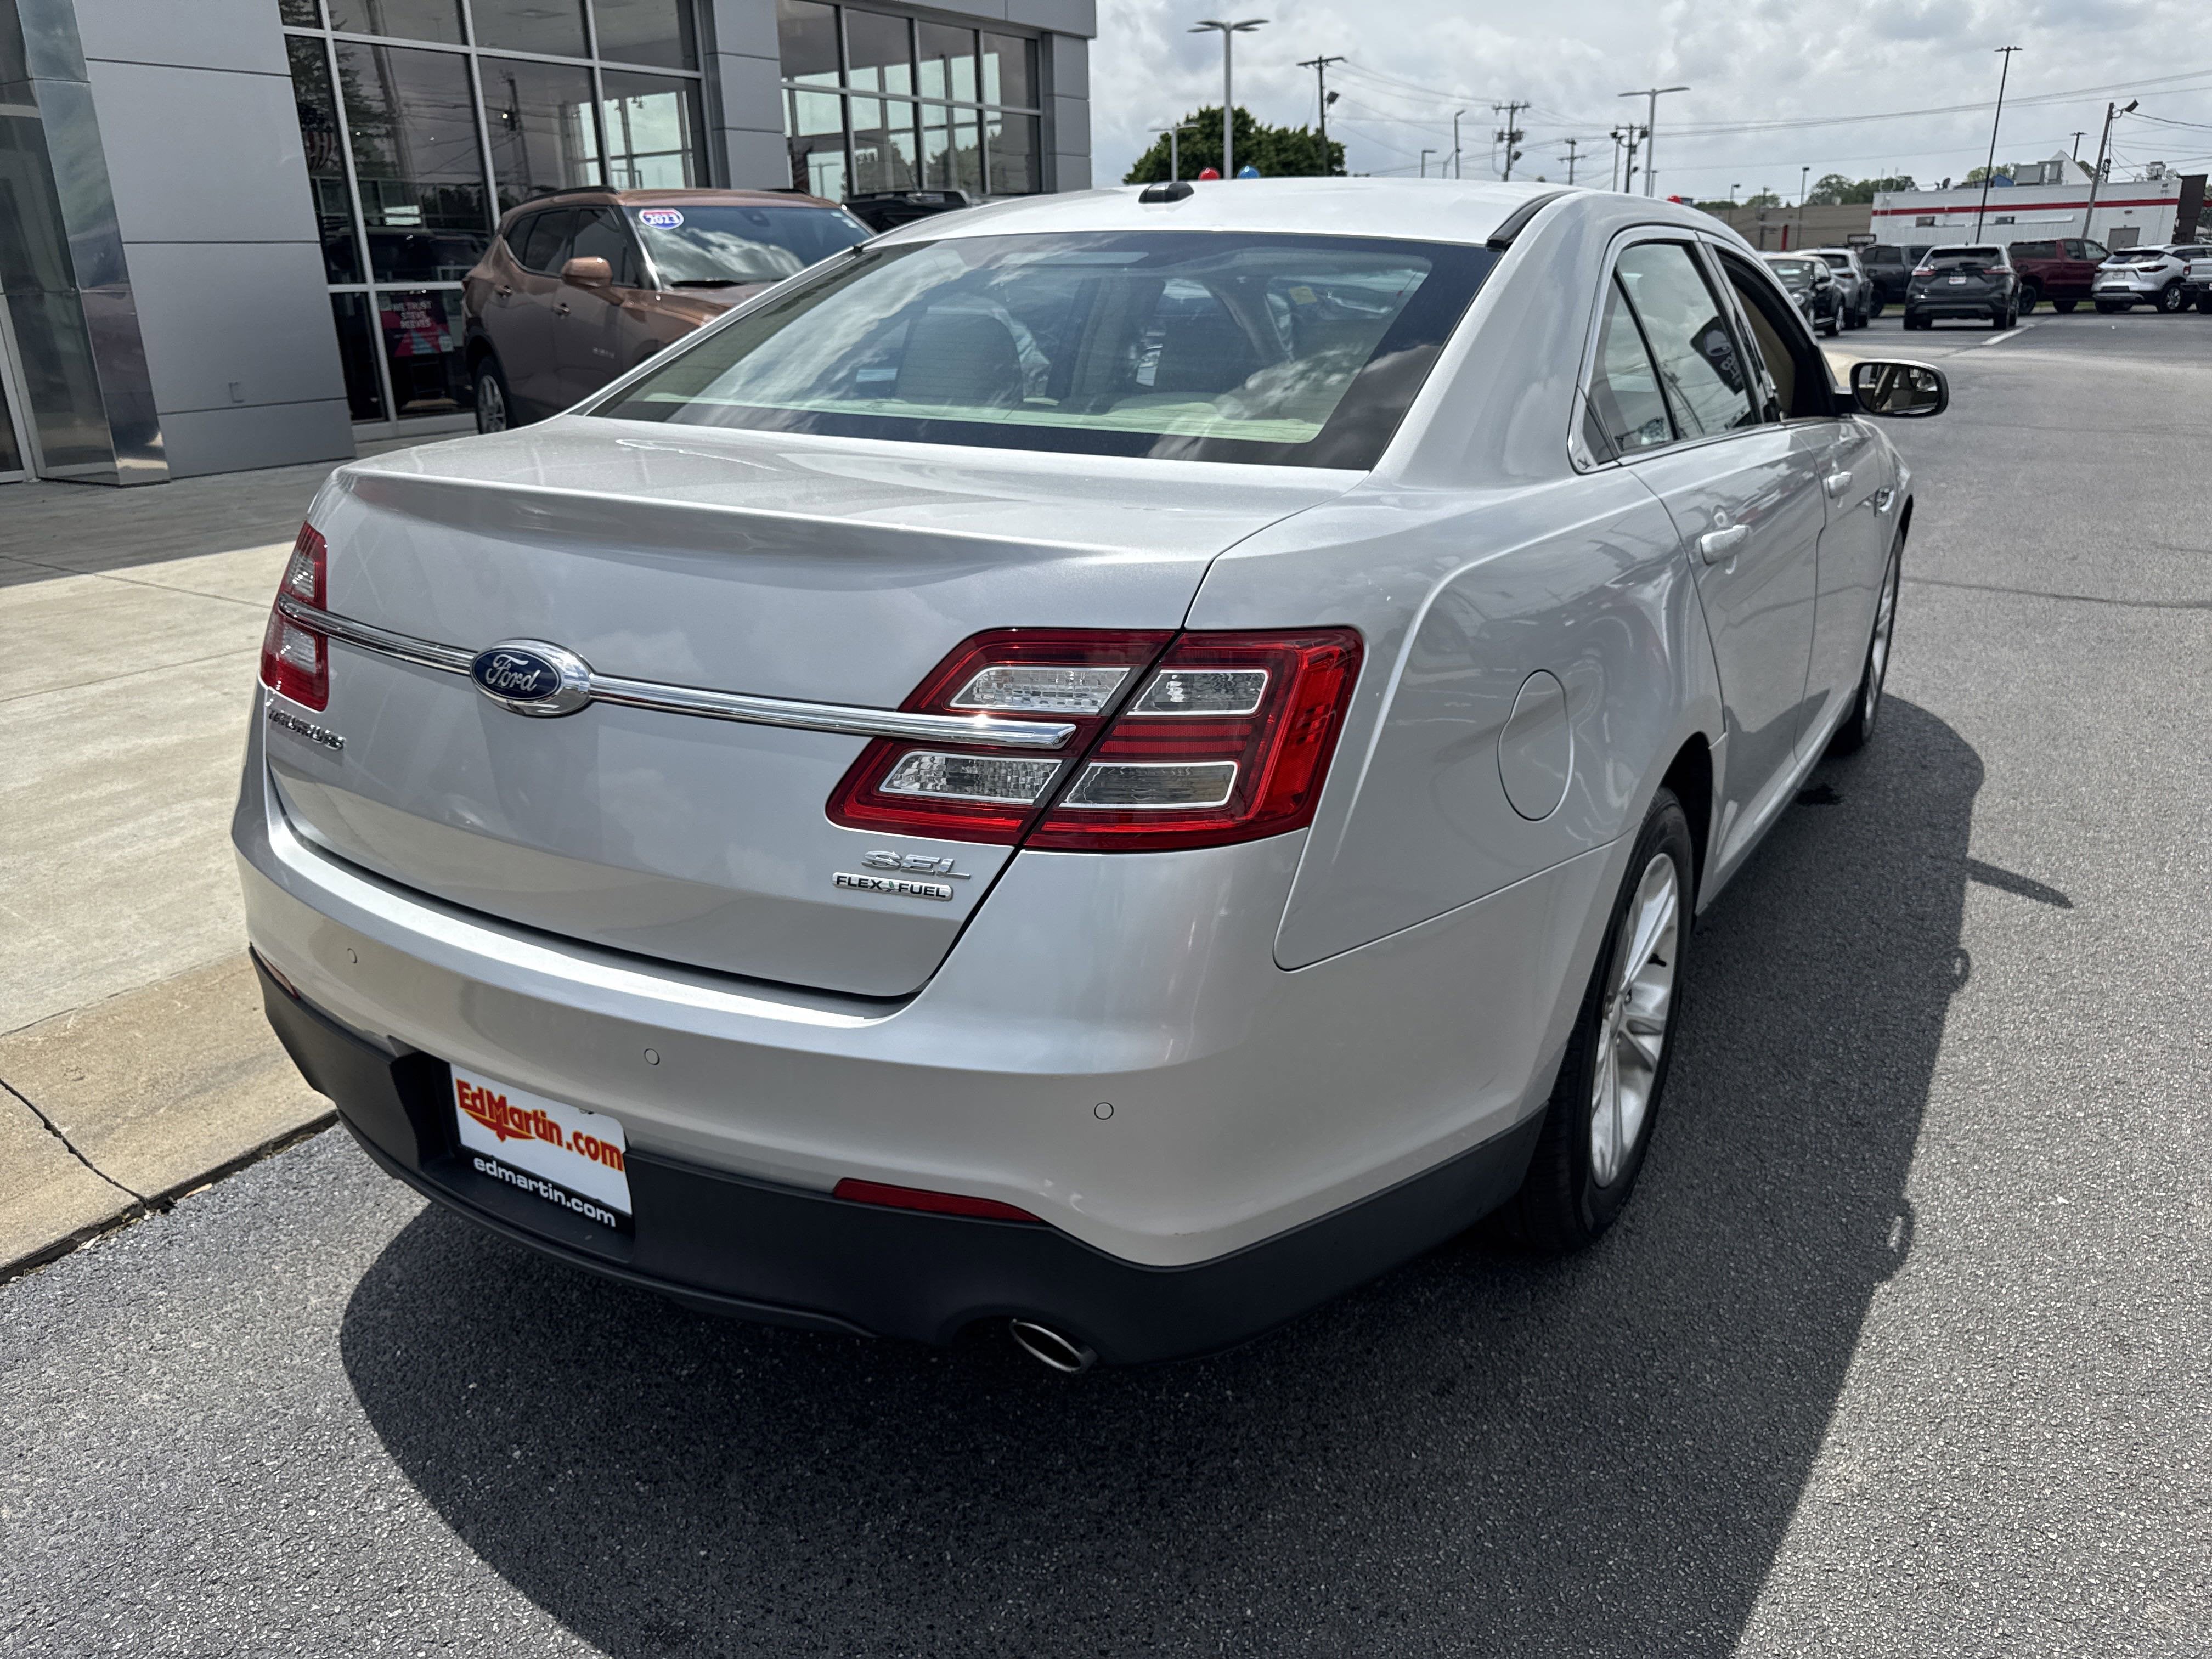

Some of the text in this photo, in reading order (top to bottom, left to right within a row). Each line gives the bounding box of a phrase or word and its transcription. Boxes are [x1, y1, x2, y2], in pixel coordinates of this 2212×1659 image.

[644, 213, 681, 225] 2023
[485, 654, 541, 692] Ford
[861, 850, 972, 879] SEL
[837, 876, 946, 898] FLEX FUEL
[473, 1157, 616, 1228] edmartin.com
